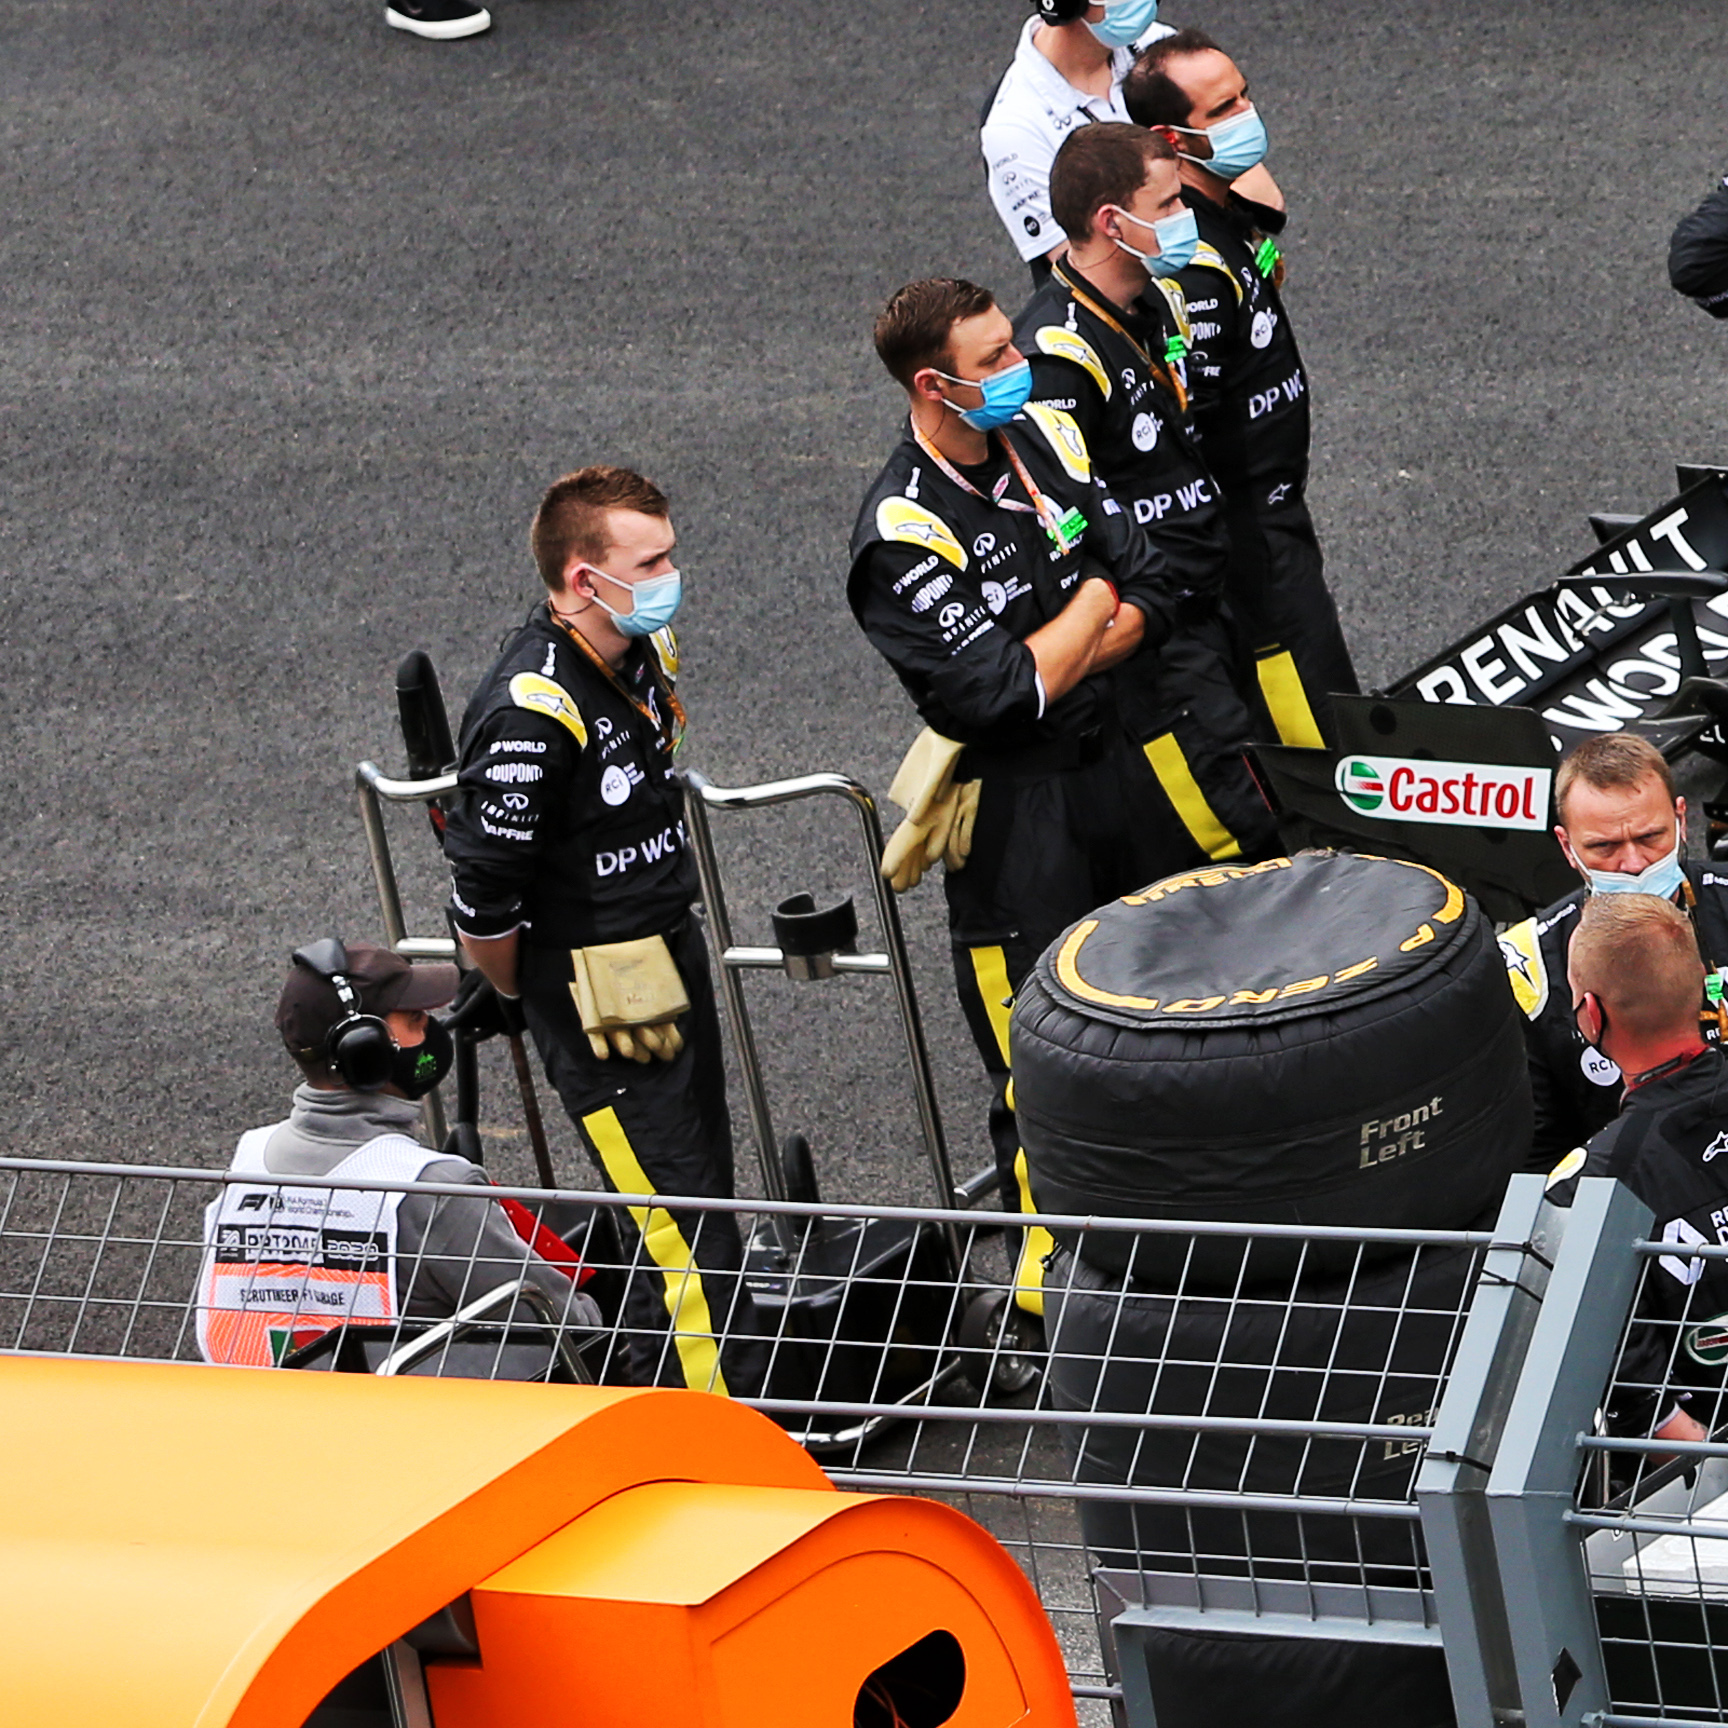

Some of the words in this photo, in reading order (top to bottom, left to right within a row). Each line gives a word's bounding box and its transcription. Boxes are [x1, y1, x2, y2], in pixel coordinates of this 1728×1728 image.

[1248, 387, 1282, 419] DP
[1133, 493, 1174, 525] DP
[899, 554, 940, 588] WORLD
[503, 740, 547, 755] WORLD
[491, 762, 538, 784] DUPONT
[604, 779, 626, 796] RCi
[1388, 767, 1538, 821] Castrol
[595, 845, 638, 877] DP
[1160, 955, 1380, 1015] ZERO
[1359, 1094, 1445, 1147] Front
[1358, 1129, 1427, 1171] Left
